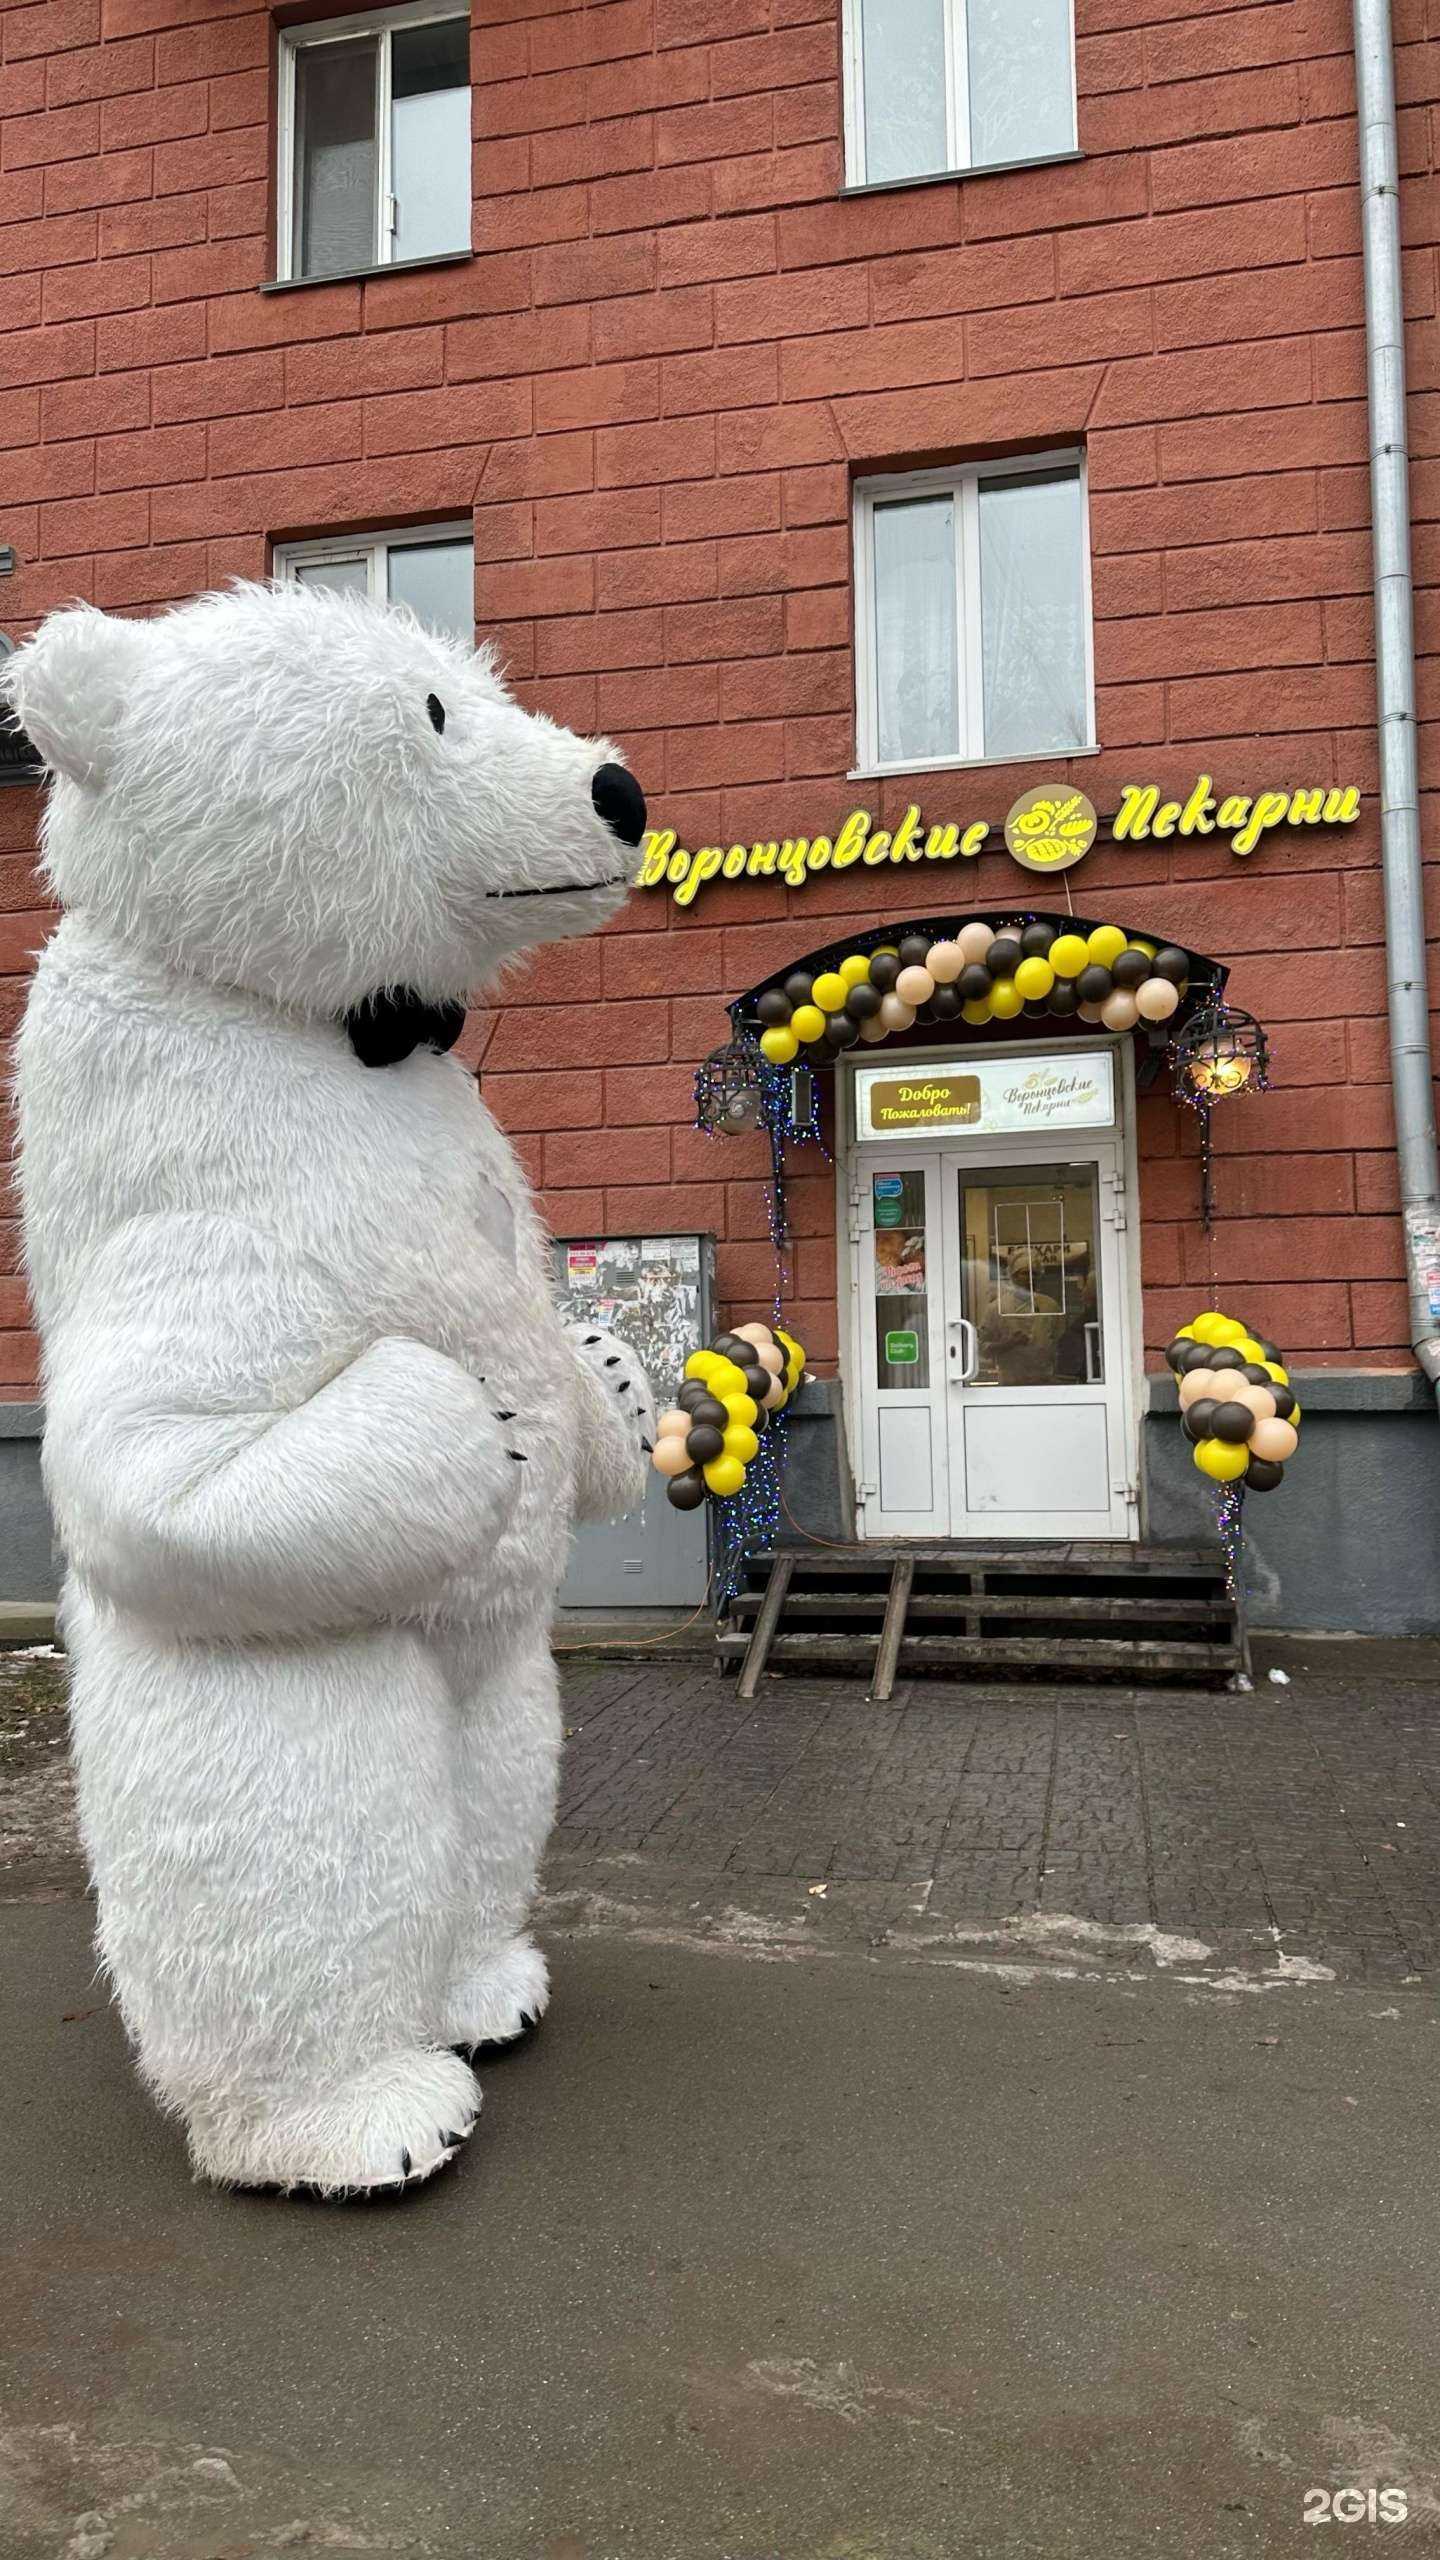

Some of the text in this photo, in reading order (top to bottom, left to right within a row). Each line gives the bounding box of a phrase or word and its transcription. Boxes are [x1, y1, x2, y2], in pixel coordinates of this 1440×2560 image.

[635, 774, 1361, 906] Воронцовские Пекарни
[898, 1084, 951, 1105] Добро
[880, 1103, 971, 1120] Пожаловать!
